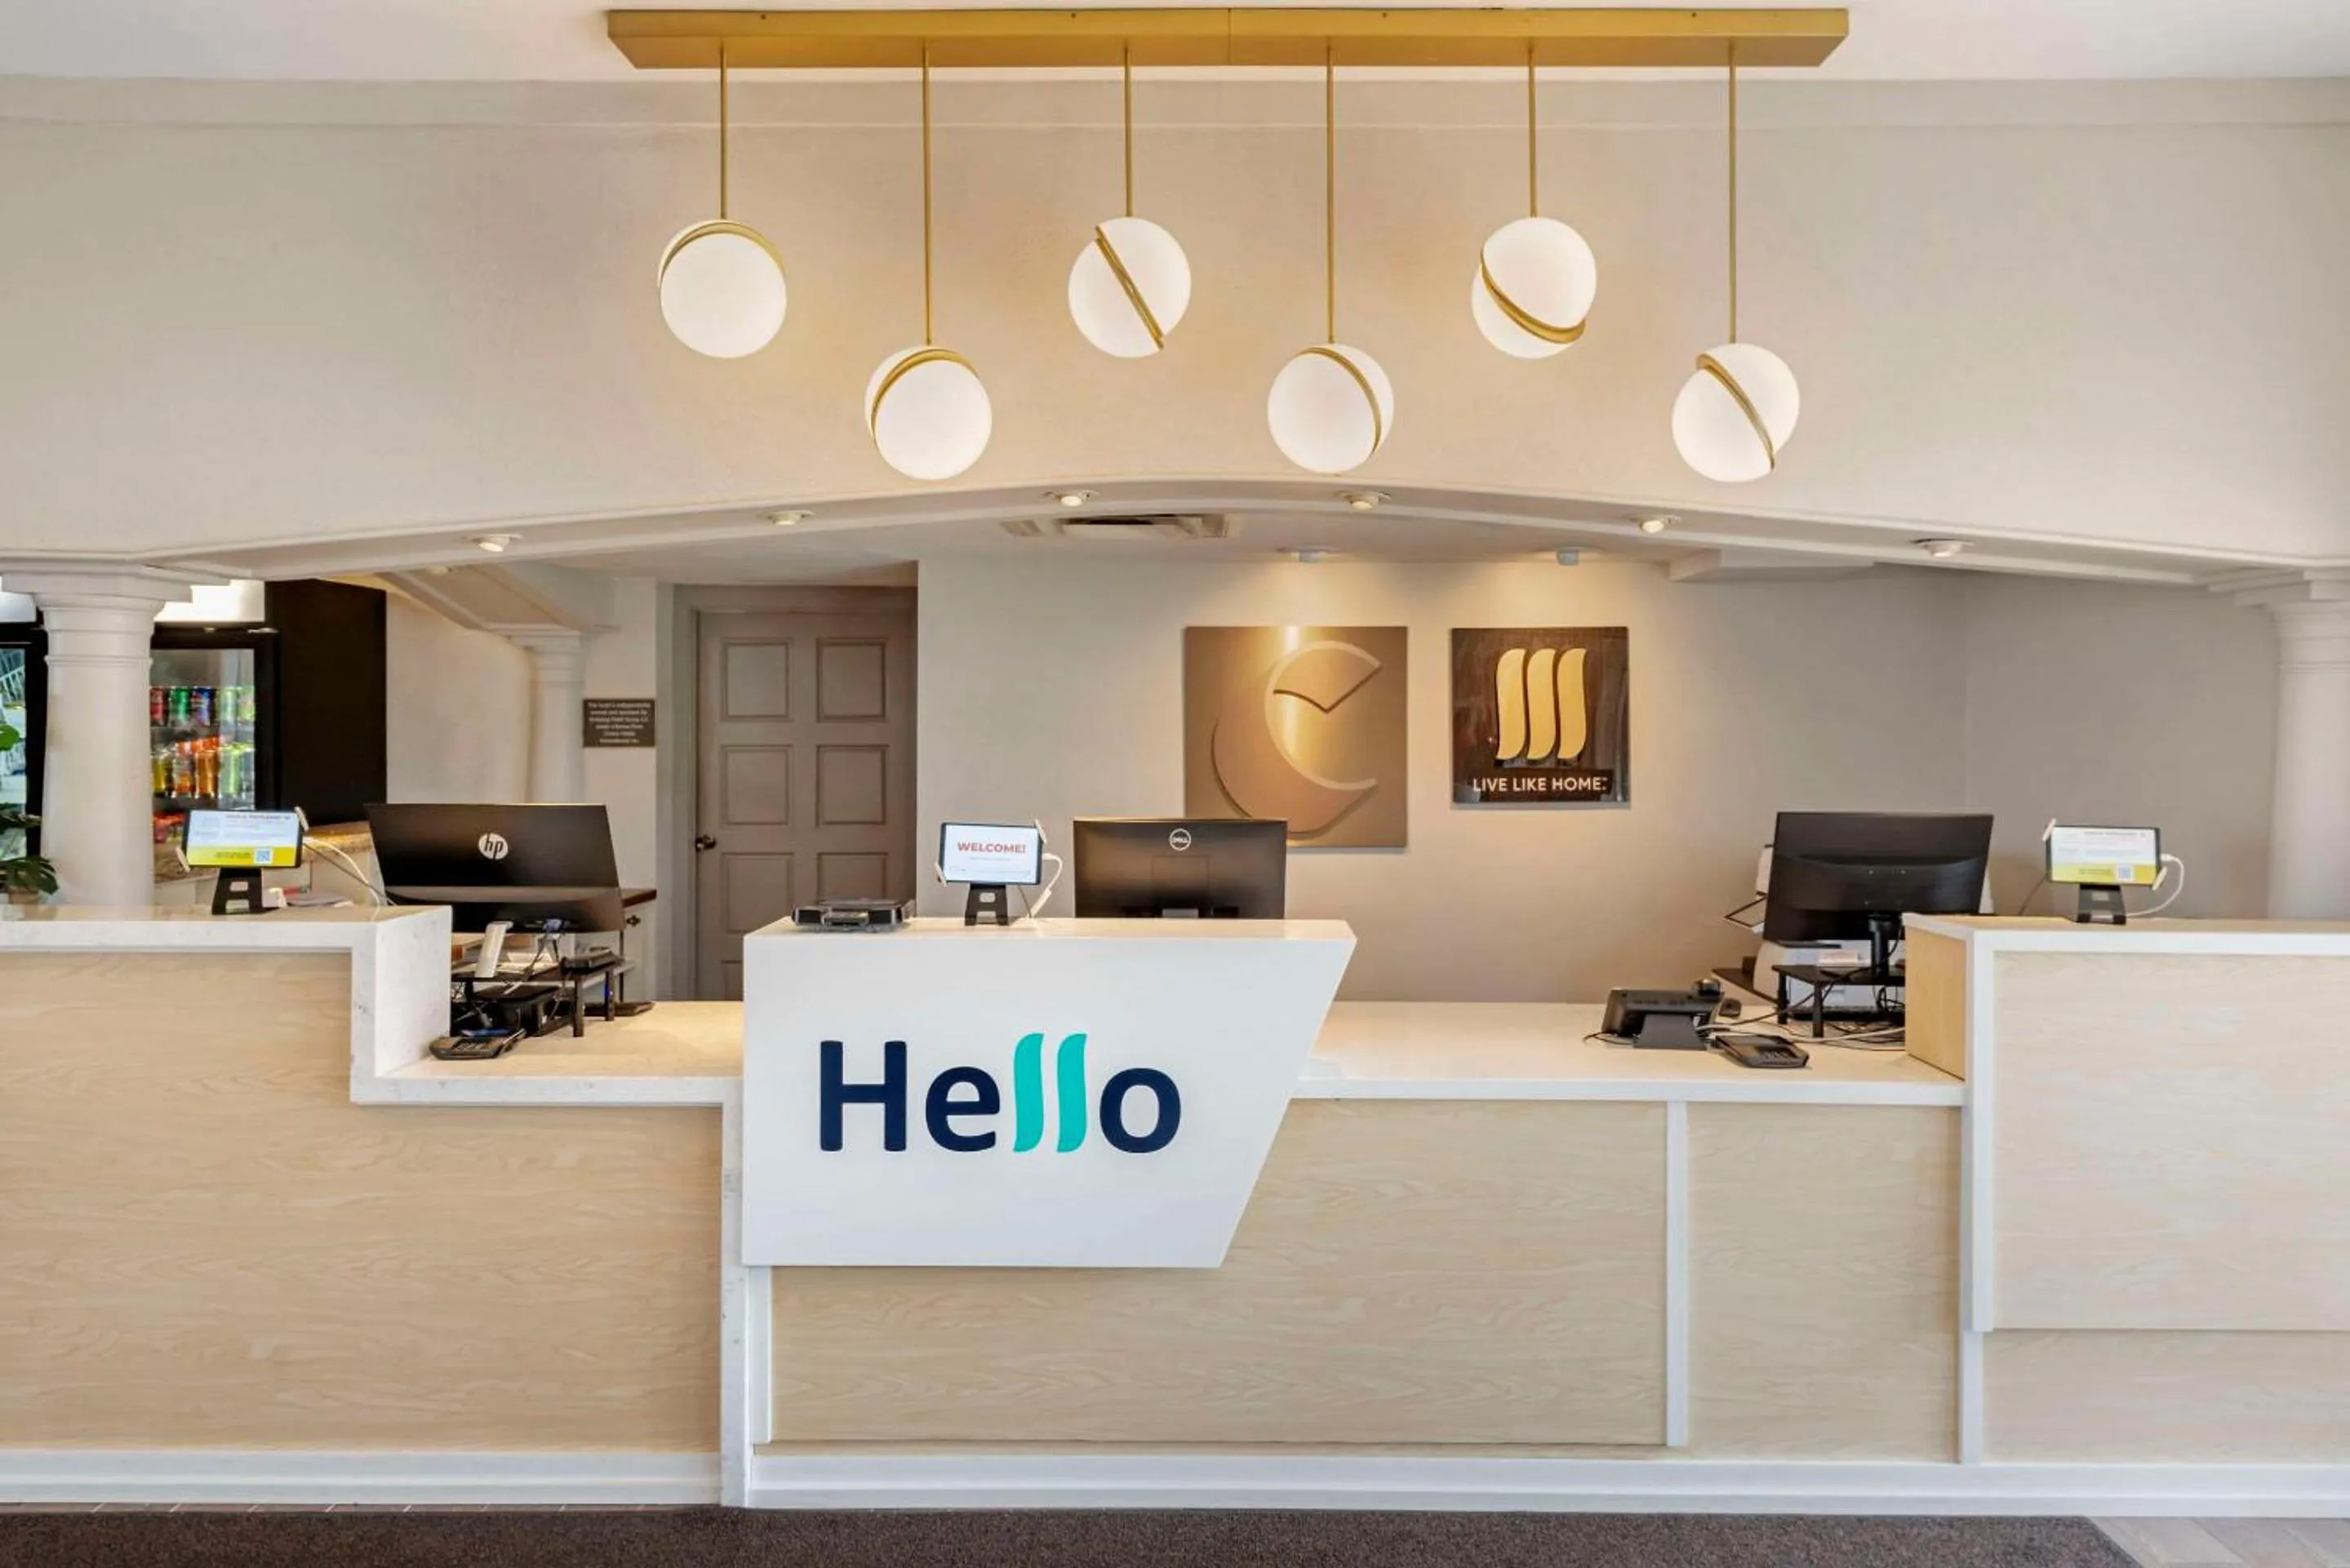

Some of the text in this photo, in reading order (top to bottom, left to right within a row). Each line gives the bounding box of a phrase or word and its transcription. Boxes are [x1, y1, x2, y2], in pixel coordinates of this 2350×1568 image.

[1473, 777, 1508, 792] LIVE
[1513, 777, 1548, 792] LIKE
[483, 833, 504, 860] hp
[957, 842, 1027, 854] WELCOME!
[820, 1033, 1182, 1153] Hello
